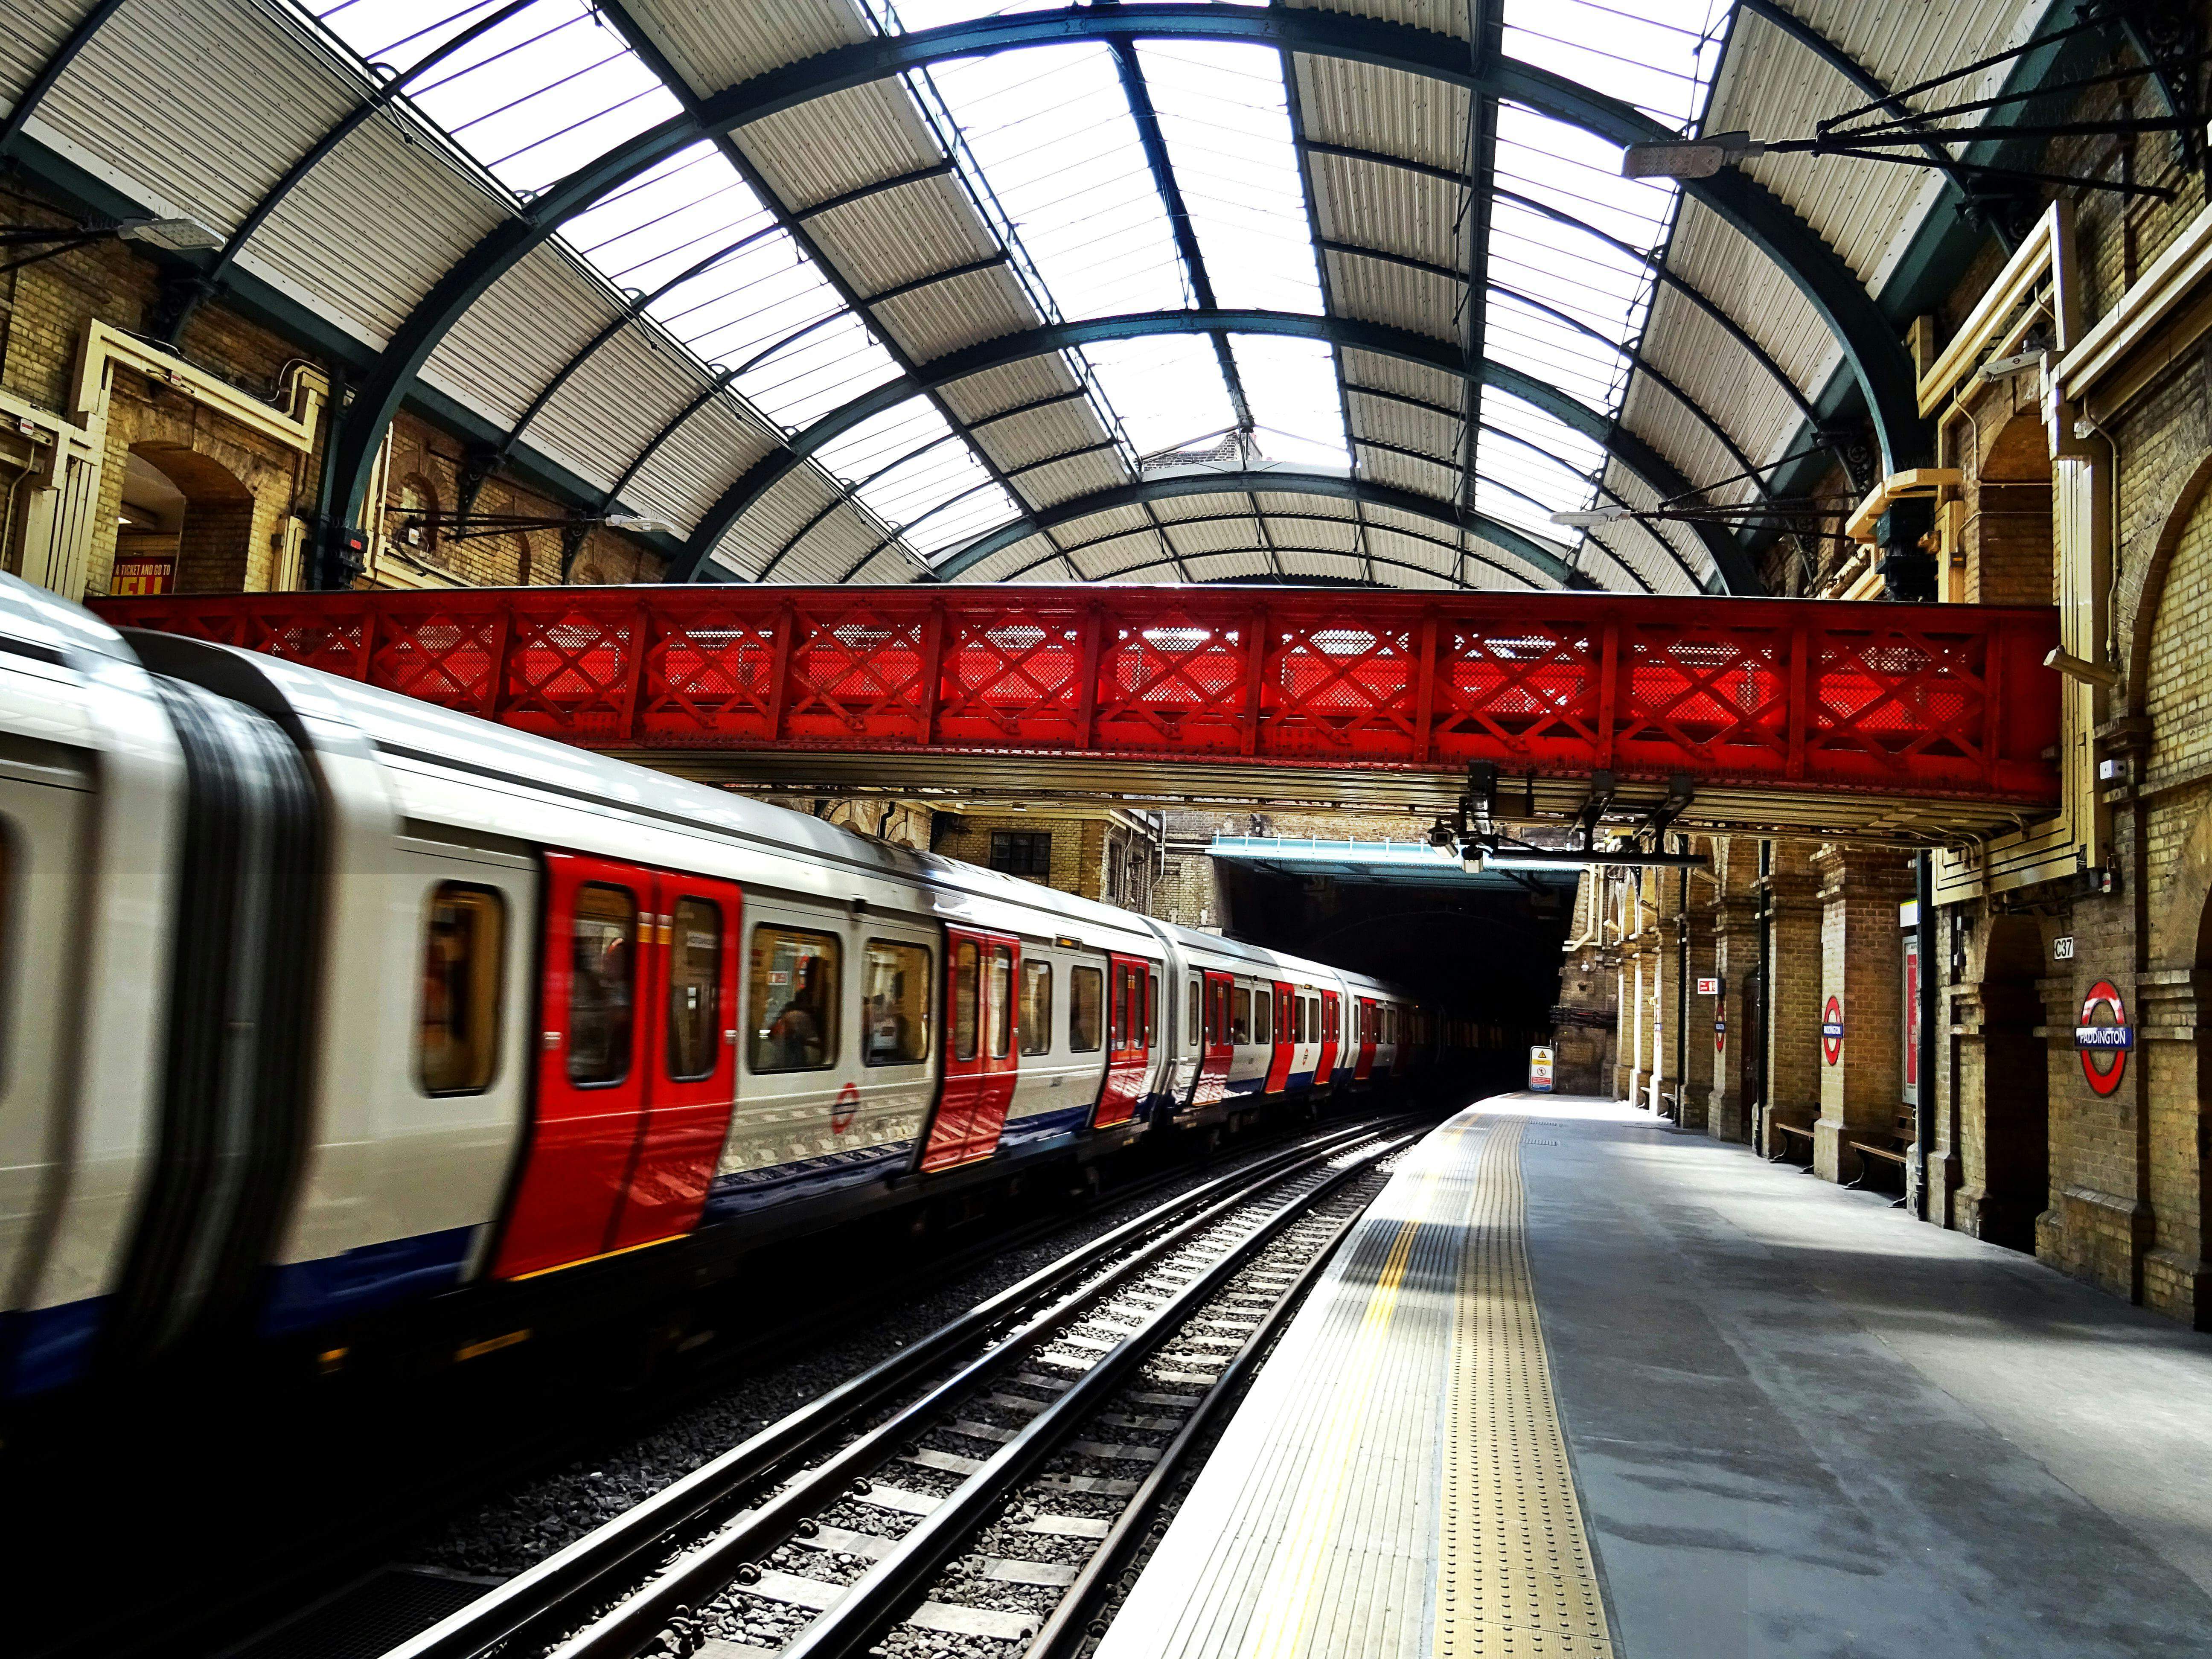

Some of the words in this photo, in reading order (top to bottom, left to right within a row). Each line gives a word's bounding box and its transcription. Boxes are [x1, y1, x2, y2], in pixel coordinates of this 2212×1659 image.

[121, 565, 140, 575] TICKET
[141, 565, 153, 575] AND
[163, 564, 171, 575] TO
[2056, 939, 2072, 957] C37
[2080, 1030, 2125, 1044] PADDINGTON
